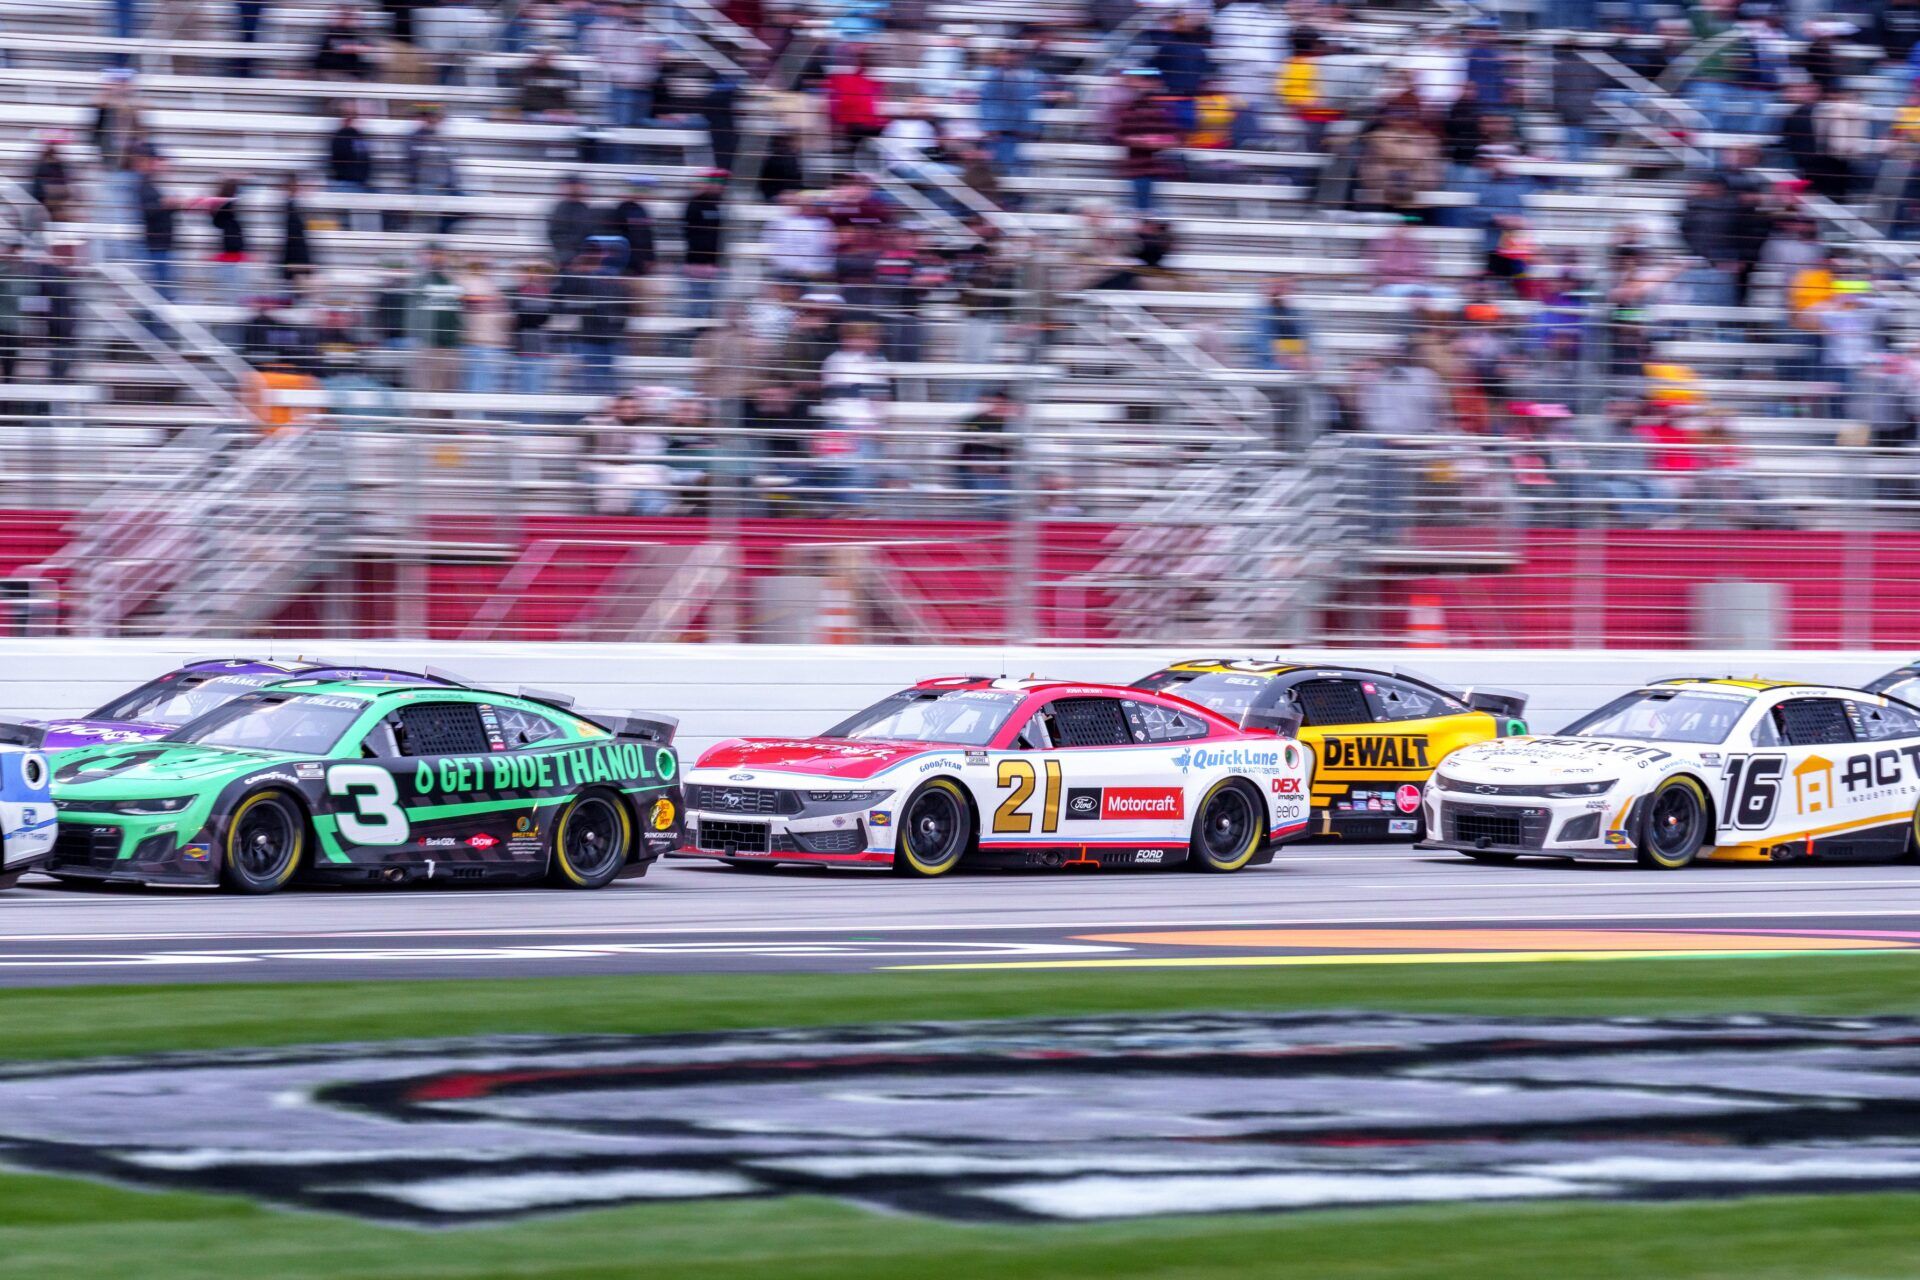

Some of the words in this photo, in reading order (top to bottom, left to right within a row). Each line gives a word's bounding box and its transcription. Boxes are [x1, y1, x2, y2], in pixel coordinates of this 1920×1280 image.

[306, 697, 361, 710] DILLON
[1193, 749, 1242, 769] Quick
[1245, 749, 1278, 766] Lane
[440, 757, 484, 793] GET
[493, 744, 652, 790] BIOETHANOL
[1228, 766, 1241, 774] TIRE
[1271, 778, 1301, 793] DEX
[1717, 753, 1787, 831] 16
[992, 759, 1062, 834] 21
[1278, 792, 1304, 800] imaging
[1847, 786, 1917, 803] INDUSTRIES
[326, 763, 410, 846] 3
[1075, 798, 1093, 809] Ford
[1108, 795, 1176, 811] Motorcraft
[1276, 804, 1299, 818] eero
[1136, 849, 1164, 858] FORD
